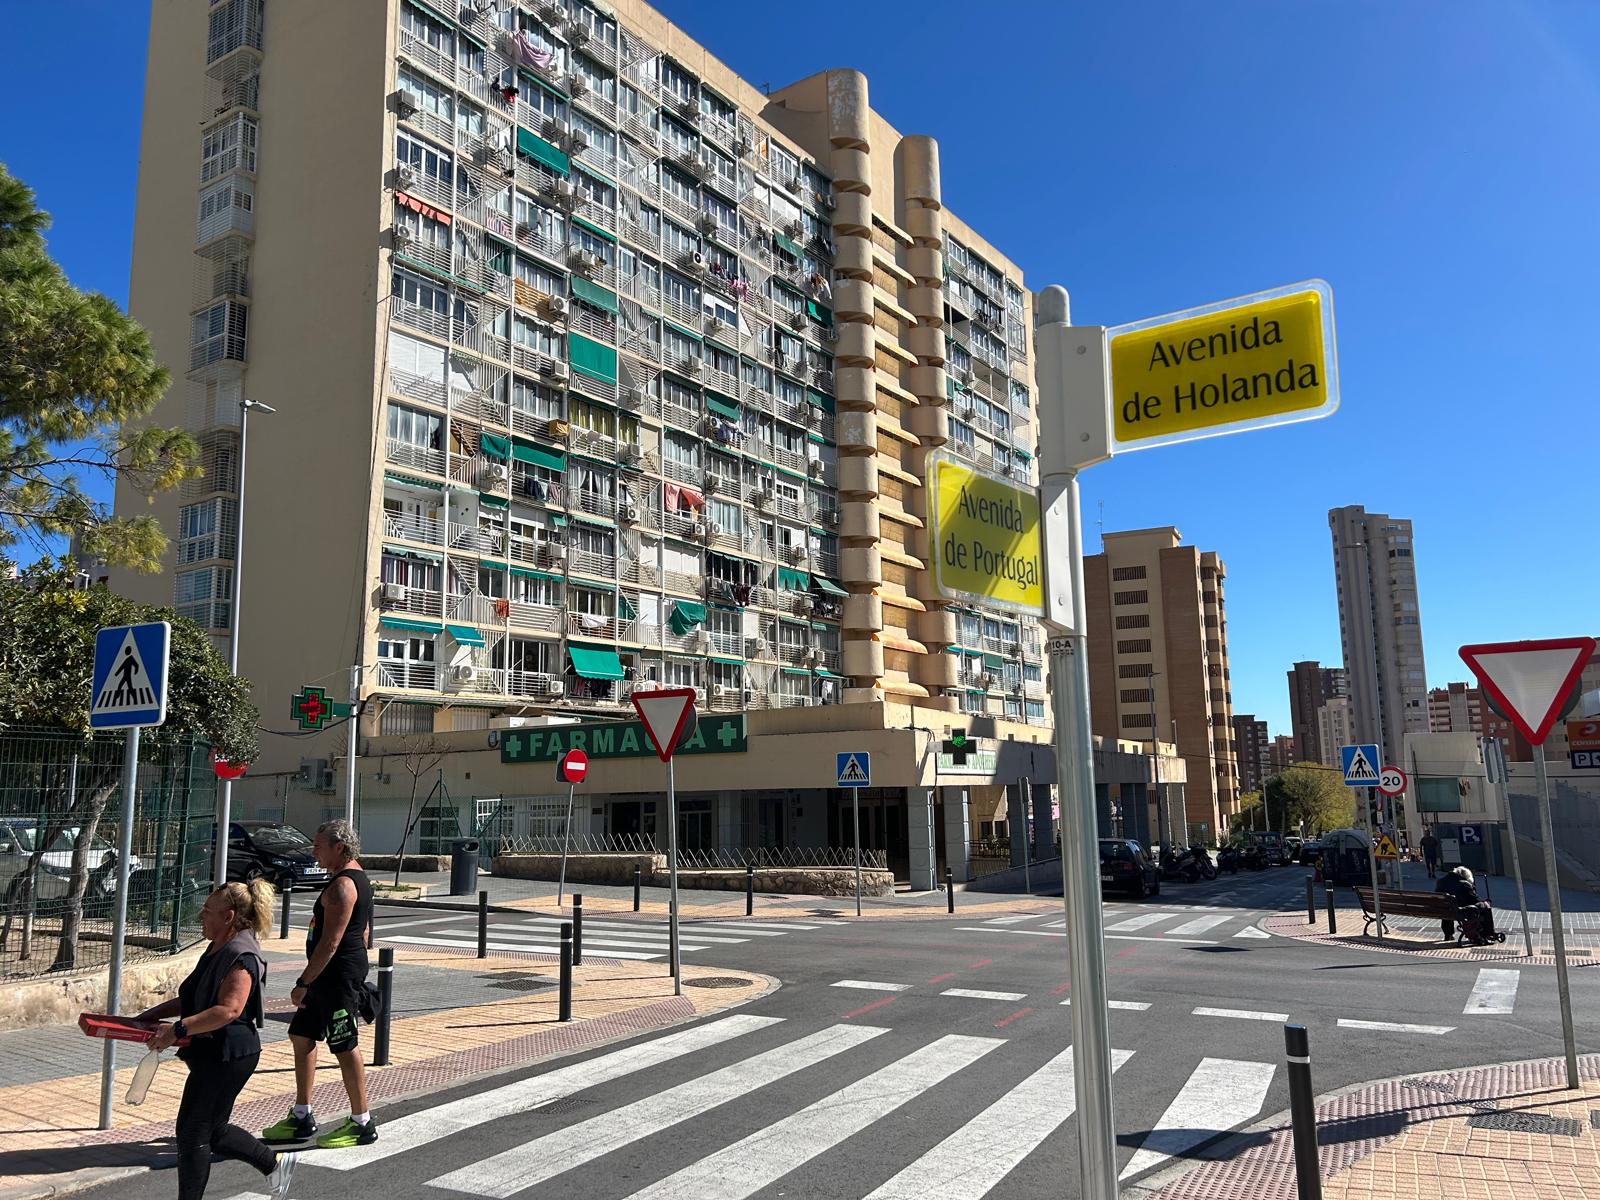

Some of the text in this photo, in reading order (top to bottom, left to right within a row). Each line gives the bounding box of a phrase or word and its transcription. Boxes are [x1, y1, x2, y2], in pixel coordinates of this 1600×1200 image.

[1149, 317, 1283, 371] Avenida
[1123, 359, 1319, 423] de Holanda
[959, 485, 1023, 533] Avenida
[945, 532, 1038, 590] de Portugal
[1052, 640, 1071, 648] 10-A
[530, 726, 706, 757] FARMAA
[1382, 776, 1400, 786] 20
[1462, 827, 1475, 841] P
